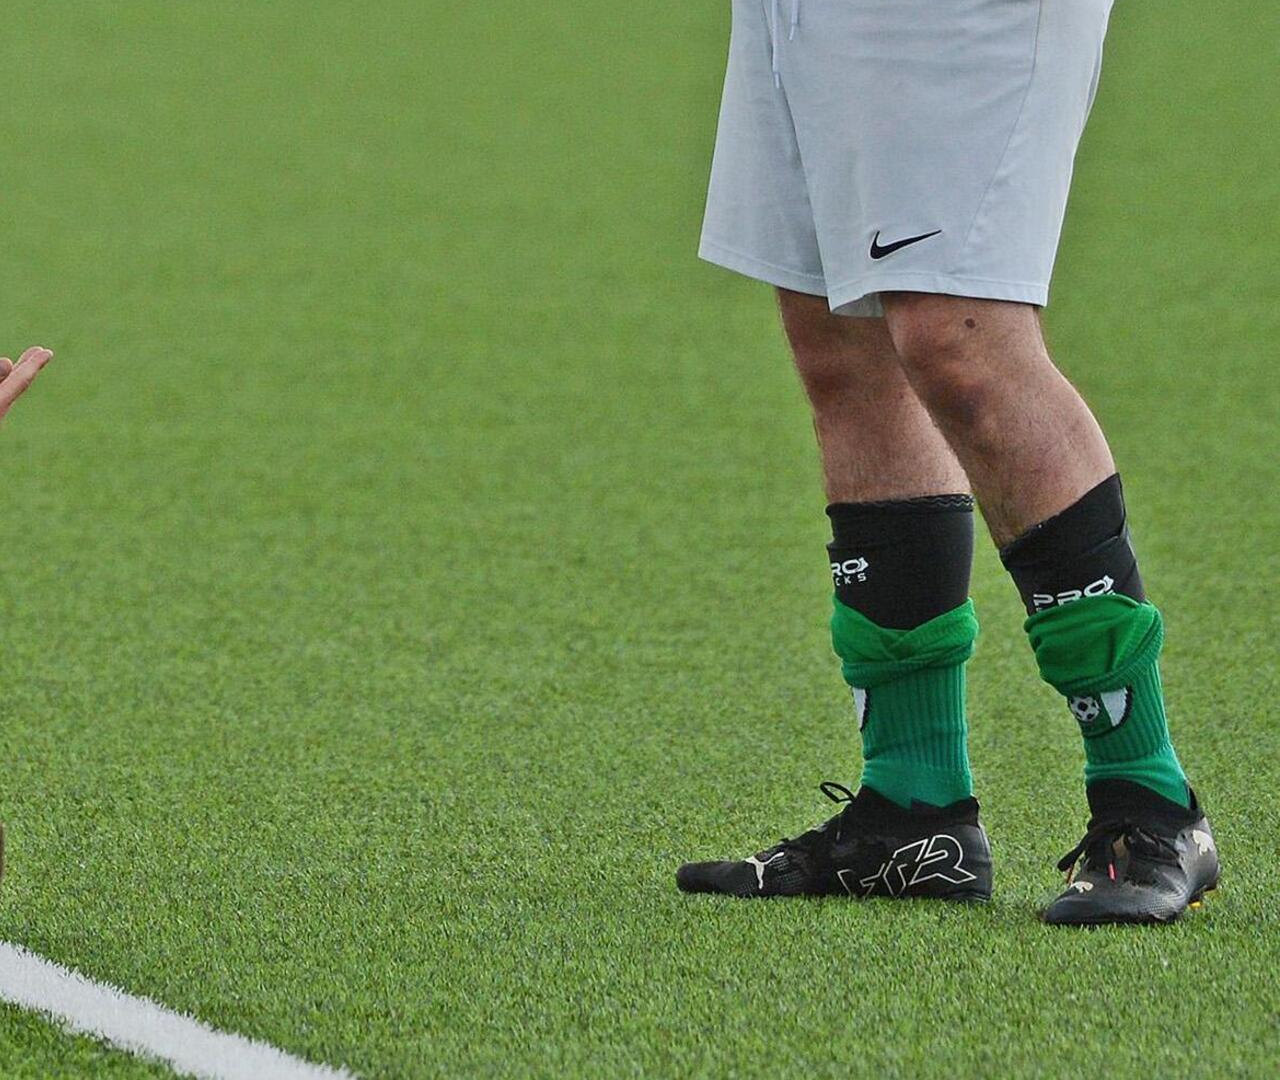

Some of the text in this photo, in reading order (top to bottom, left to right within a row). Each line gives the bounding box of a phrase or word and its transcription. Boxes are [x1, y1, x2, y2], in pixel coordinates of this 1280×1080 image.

[831, 557, 868, 576] RO
[835, 572, 867, 587] CKS
[1032, 575, 1114, 607] PRO
